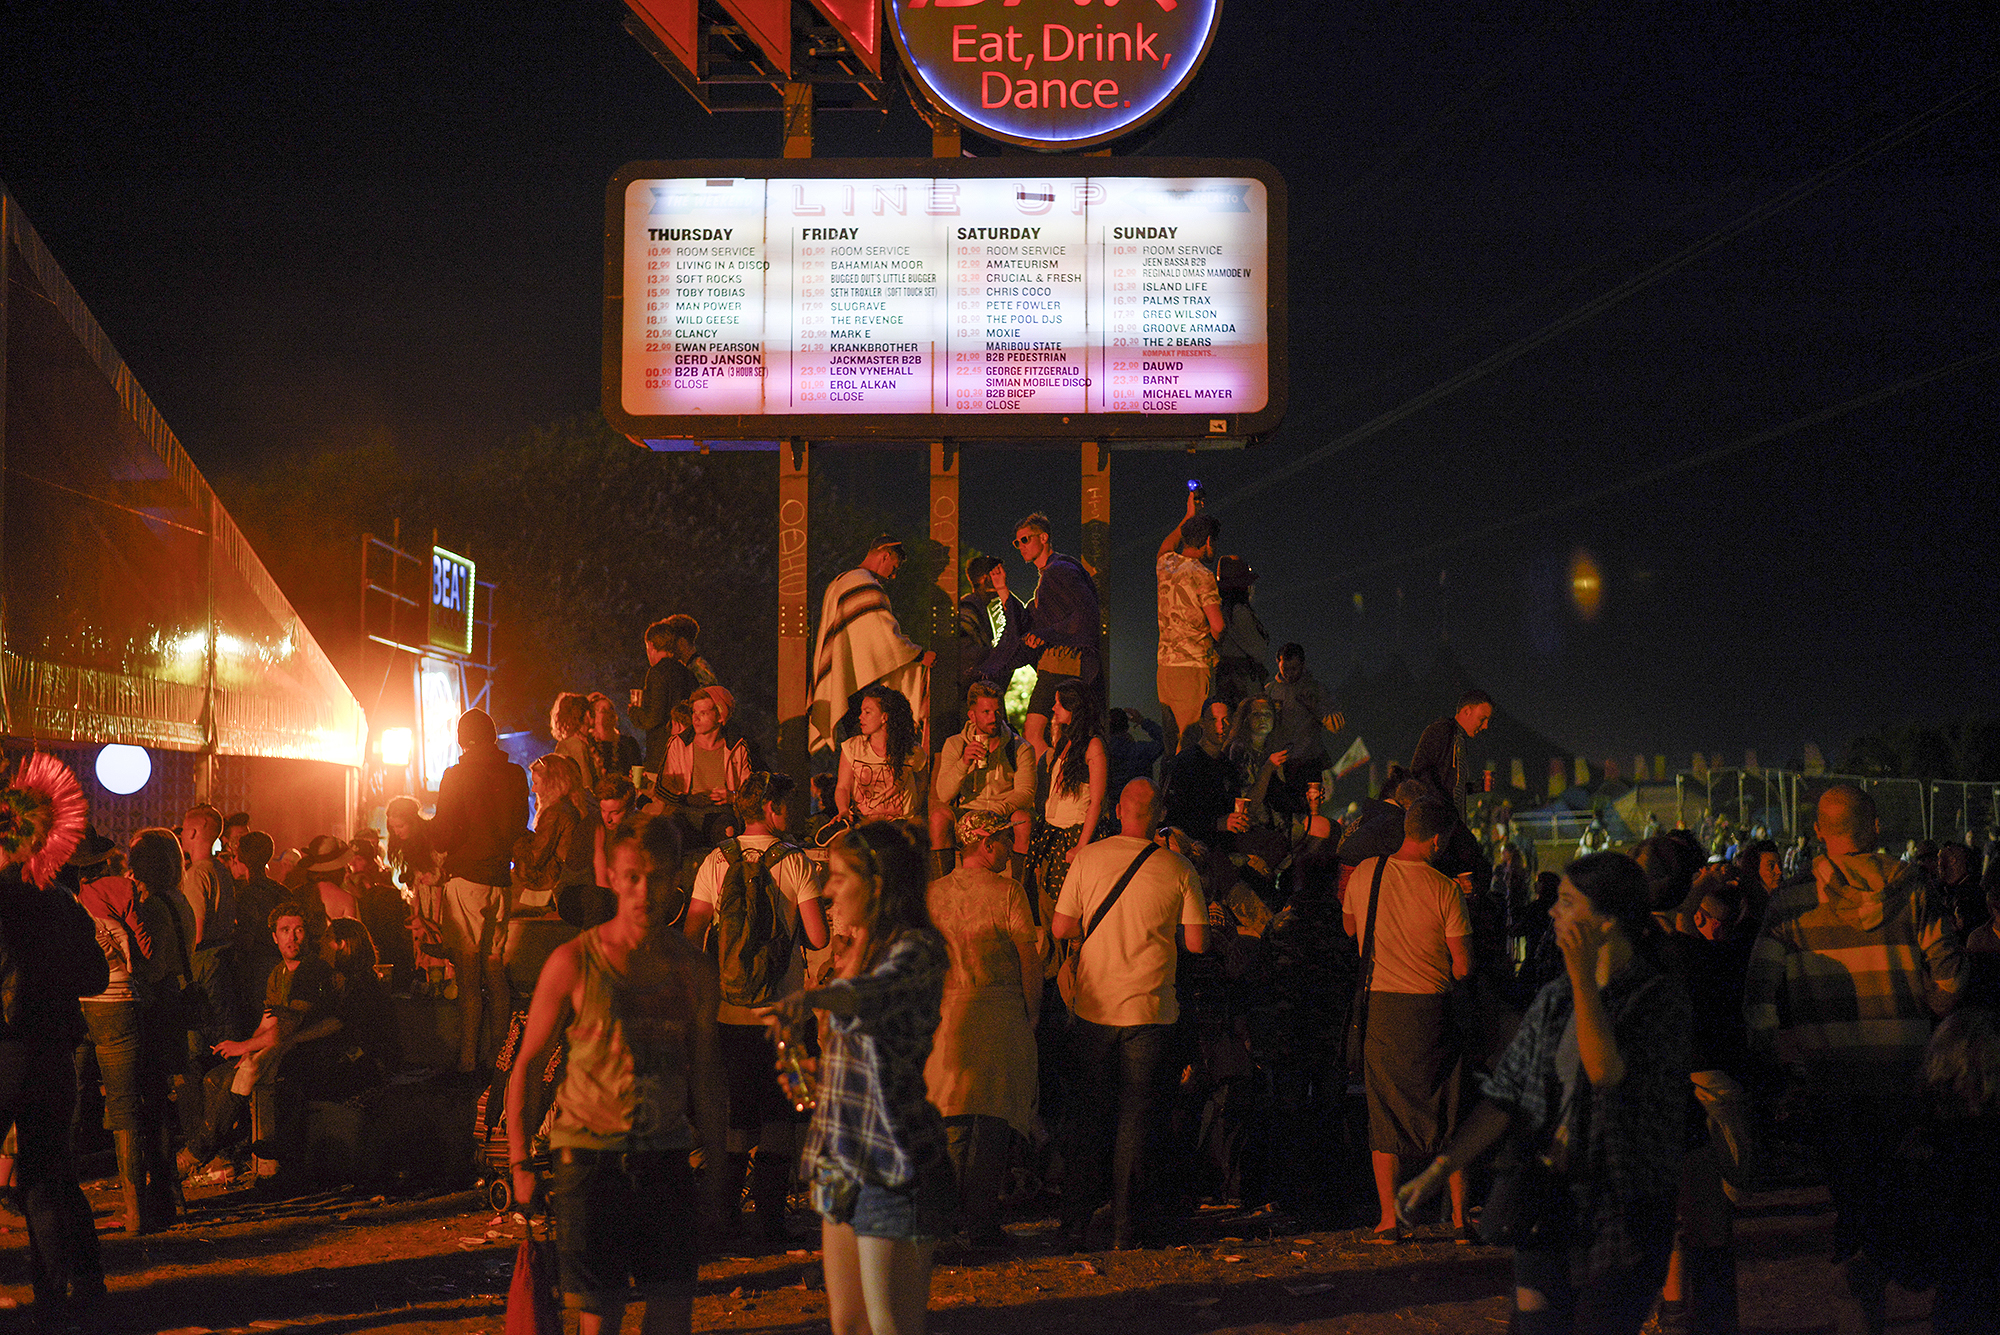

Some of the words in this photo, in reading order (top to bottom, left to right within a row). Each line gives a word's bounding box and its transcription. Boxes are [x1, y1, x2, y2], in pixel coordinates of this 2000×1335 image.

[953, 24, 1035, 71] Eat,
[1042, 22, 1172, 71] Drink,
[981, 71, 1131, 110] Dance.
[792, 184, 960, 216] LINE
[1013, 183, 1106, 216] UP
[648, 229, 733, 240] THURSDAY
[802, 228, 859, 240] FRIDAY
[957, 227, 1041, 240] SATURDAY
[1114, 227, 1178, 239] SUNDAY
[677, 247, 708, 256] ROOM
[712, 247, 755, 256] SERVICE
[831, 247, 862, 256] ROOM
[866, 247, 910, 256] SERVICE
[986, 246, 1018, 255] ROOM
[1022, 246, 1066, 255] SERVICE
[1143, 246, 1174, 254] ROOM
[1178, 246, 1222, 254] SERVICE
[677, 261, 712, 270] LIVING
[715, 261, 725, 270] IN
[728, 261, 735, 270] A
[738, 261, 770, 270] DISCO
[831, 261, 888, 269] BAHAMIAN
[892, 261, 923, 269] MOOR
[986, 260, 1058, 268] AMATEURISM
[1143, 258, 1162, 266] JEEN
[1165, 258, 1188, 266] BASSA
[1191, 258, 1206, 266] B2B
[1143, 269, 1180, 277] REGINALD
[1183, 269, 1204, 277] OMAS
[1207, 269, 1241, 277] MAMODE
[1243, 269, 1251, 277] IV
[676, 275, 703, 284] SOFT
[706, 275, 742, 284] ROCKS
[831, 274, 859, 283] BUGGED
[883, 274, 906, 283] LITTLE
[908, 274, 936, 282] BUGGER
[986, 274, 1032, 282] CRUCIAL
[1036, 274, 1043, 282] &
[1047, 274, 1082, 282] FRESH
[1143, 283, 1182, 291] ISLAND
[1186, 283, 1207, 291] LIFE
[676, 288, 704, 297] TOBY
[708, 288, 745, 297] TOBIAS
[830, 288, 848, 297] SETH
[851, 288, 882, 297] TROXLER
[986, 288, 1019, 296] CHRIS
[1022, 287, 1051, 296] COCO
[1143, 296, 1179, 305] PALMS
[1183, 296, 1211, 305] TRAX
[676, 302, 700, 310] MAN
[703, 302, 742, 310] POWER
[830, 302, 886, 311] SLUGRAVE
[986, 301, 1013, 310] PETE
[1016, 301, 1060, 310] FOWLER
[1143, 310, 1171, 318] GREG
[1175, 310, 1217, 318] WILSON
[676, 316, 703, 324] WILD
[706, 316, 740, 324] GEESE
[831, 316, 851, 324] THE
[855, 316, 903, 324] REVENGE
[986, 315, 1008, 323] THE
[1011, 315, 1038, 323] POOL
[1042, 315, 1062, 323] DJS
[1143, 324, 1186, 332] GROOVE
[1190, 324, 1236, 332] ARMADA
[675, 330, 718, 338] CLANCY
[830, 330, 862, 338] MARK
[865, 330, 871, 338] E
[986, 329, 1020, 337] MOXIE
[986, 342, 1030, 350] MARIBOU
[1033, 342, 1061, 350] STATE
[1143, 338, 1163, 346] THE
[1167, 338, 1173, 346] 2
[1176, 338, 1211, 346] BEARS
[675, 343, 706, 352] EWAN
[710, 343, 759, 352] PEARSON
[830, 343, 918, 352] KRANKBROTHER
[675, 355, 708, 365] GERD
[711, 355, 761, 365] JANSON
[830, 356, 899, 364] JACKMASTER
[902, 356, 922, 364] B2B
[986, 353, 1004, 361] B2B
[1007, 353, 1066, 361] PEDESTRIAN
[1143, 362, 1183, 370] DAUWD
[675, 367, 698, 376] B2B
[702, 367, 724, 376] ATA
[728, 366, 735, 378] (3
[736, 367, 754, 377] HOUR
[754, 366, 768, 378] SET)
[830, 367, 856, 375] LEON
[860, 367, 913, 375] VYNEHALL
[986, 367, 1022, 375] GEORGE
[1025, 367, 1079, 375] FITZGERALD
[986, 378, 1020, 386] SIMIAN
[1023, 378, 1060, 386] MOBILE
[1063, 378, 1092, 386] DISCO
[1143, 376, 1179, 384] BARNT
[675, 380, 709, 389] CLOSE
[861, 381, 896, 389] ALKAN
[830, 392, 864, 401] CLOSE
[986, 389, 1005, 397] B2B
[1008, 389, 1035, 397] BICEP
[1143, 390, 1191, 398] MICHAEL
[1195, 390, 1232, 398] MAYER
[986, 401, 1020, 409] CLOSE
[1143, 401, 1177, 410] CLOSE
